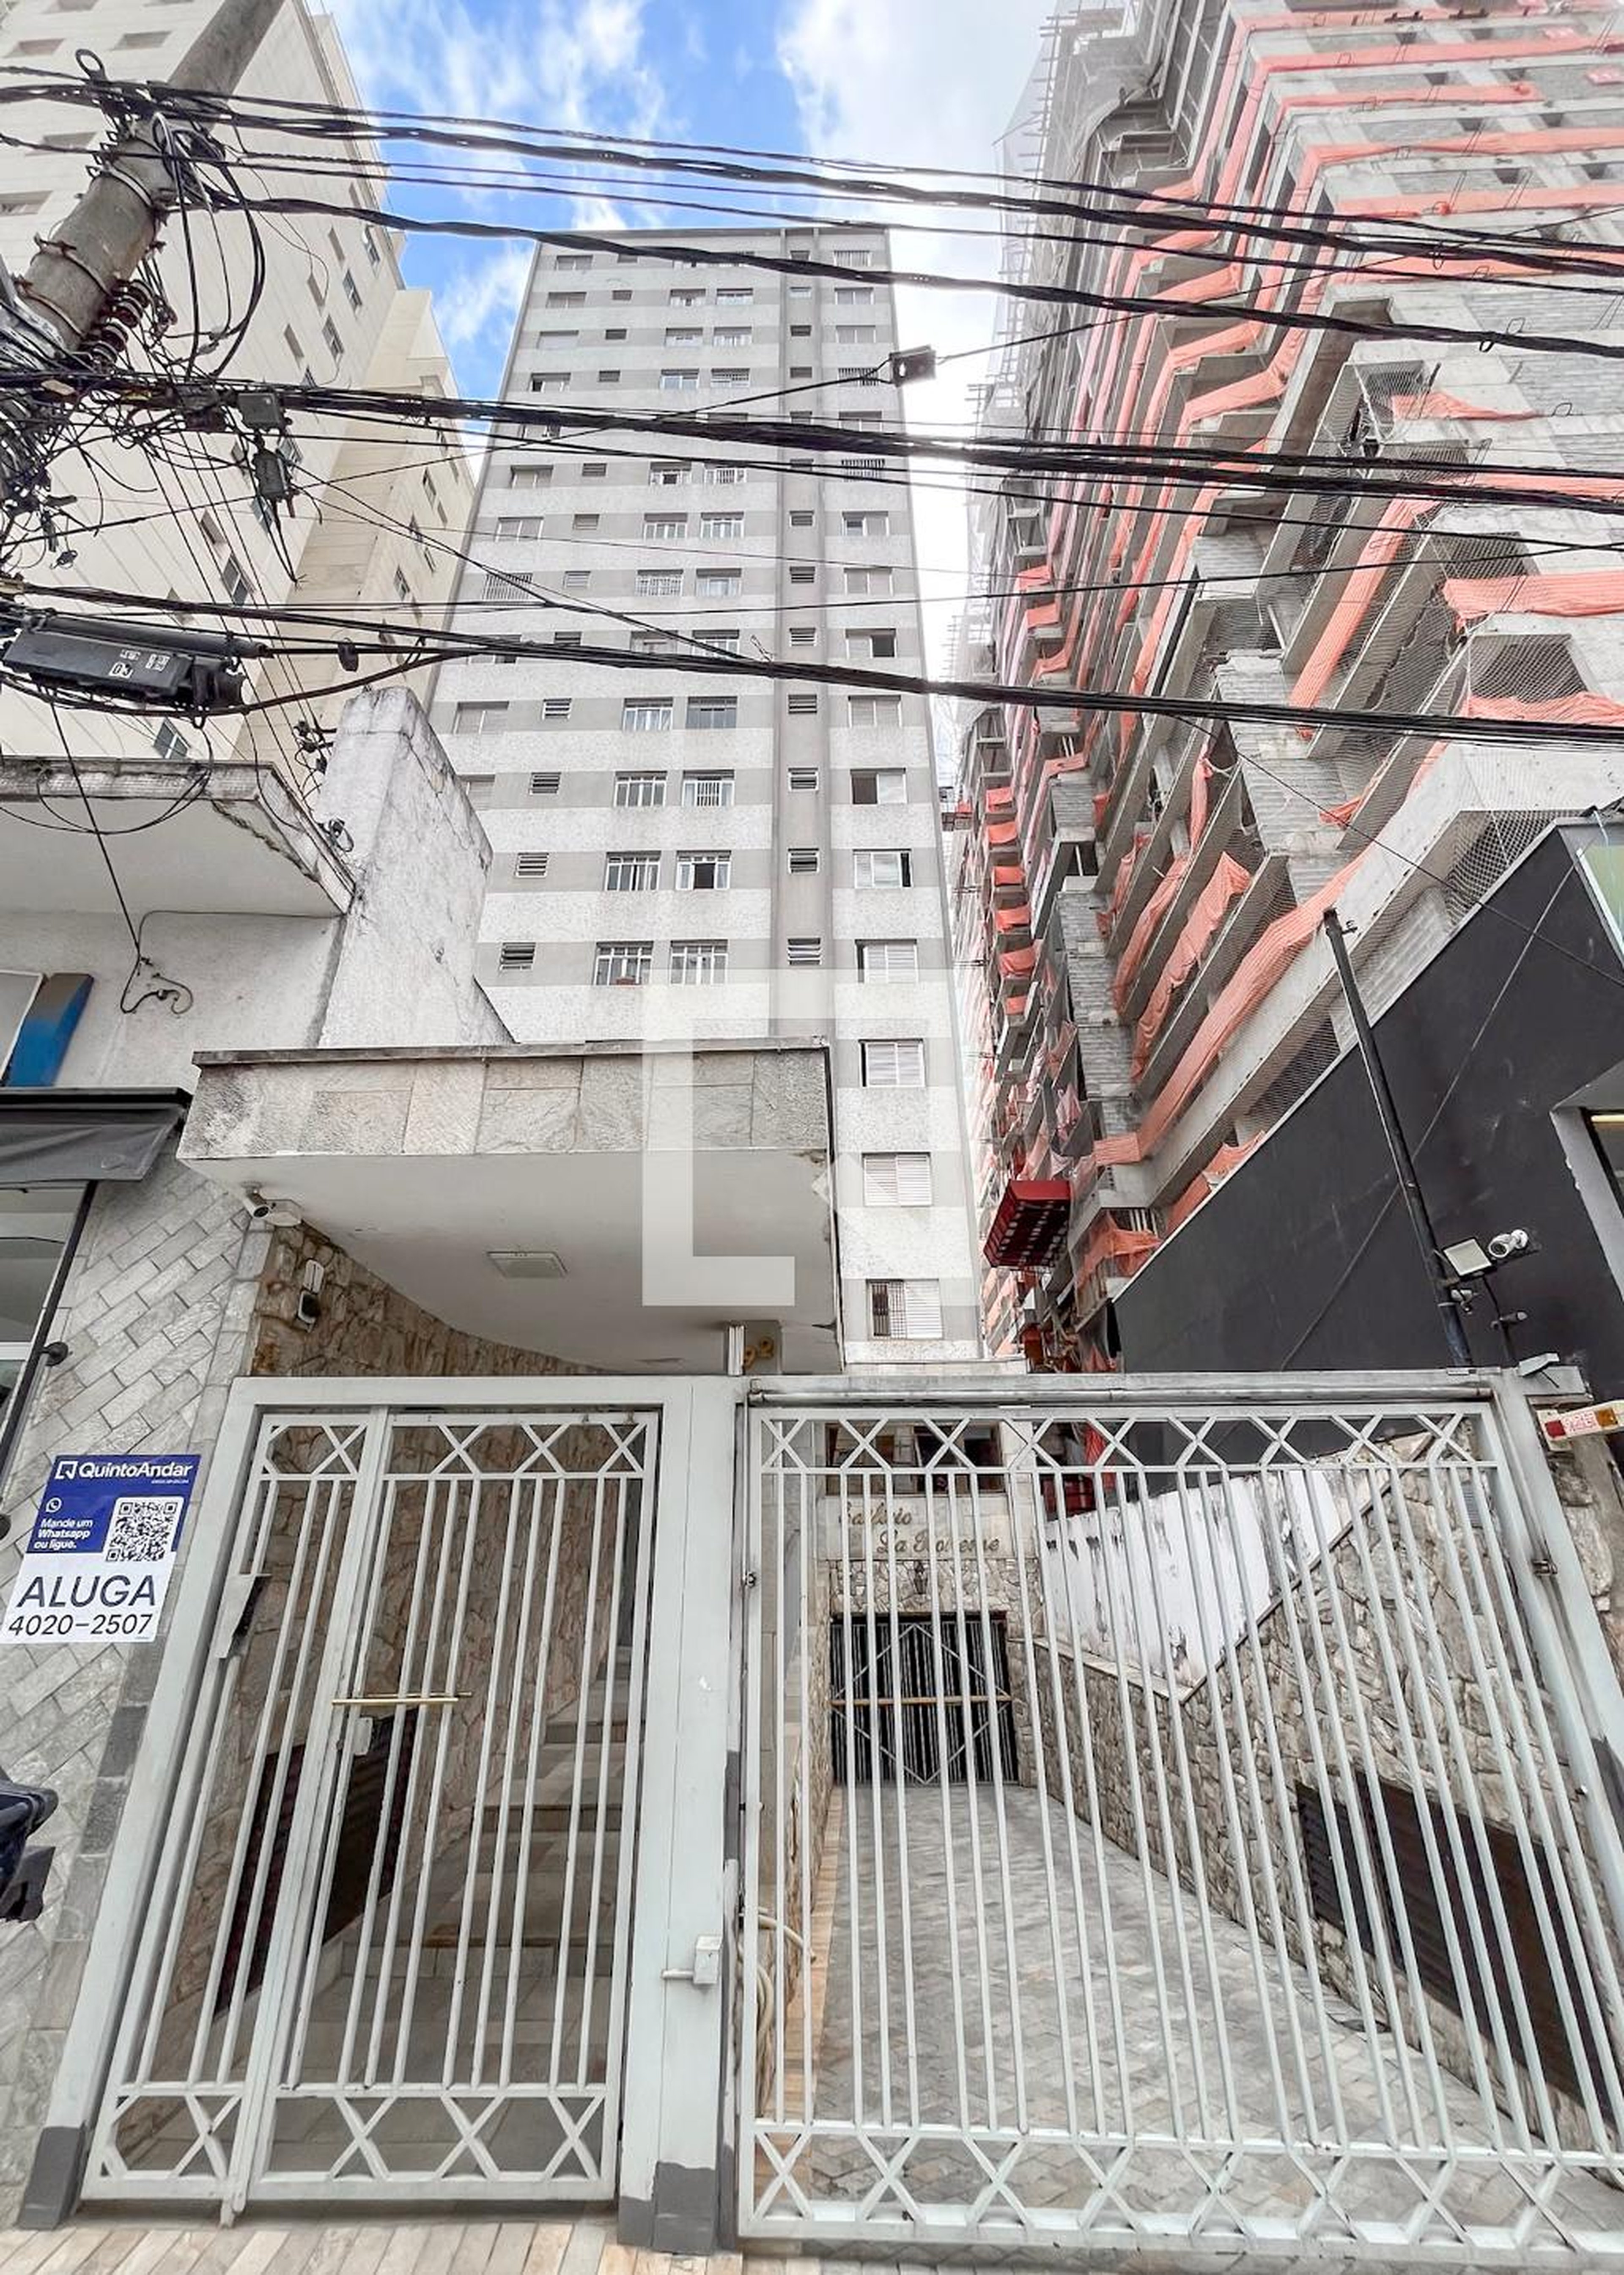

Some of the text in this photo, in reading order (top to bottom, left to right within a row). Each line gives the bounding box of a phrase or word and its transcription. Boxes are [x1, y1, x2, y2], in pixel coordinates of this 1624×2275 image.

[79, 1462, 193, 1478] QuintoAndar
[41, 1518, 75, 1528] Mande
[38, 1529, 91, 1540] Whatsapp
[16, 1575, 156, 1607] ALUGA
[8, 1614, 153, 1635] 4020-2507
